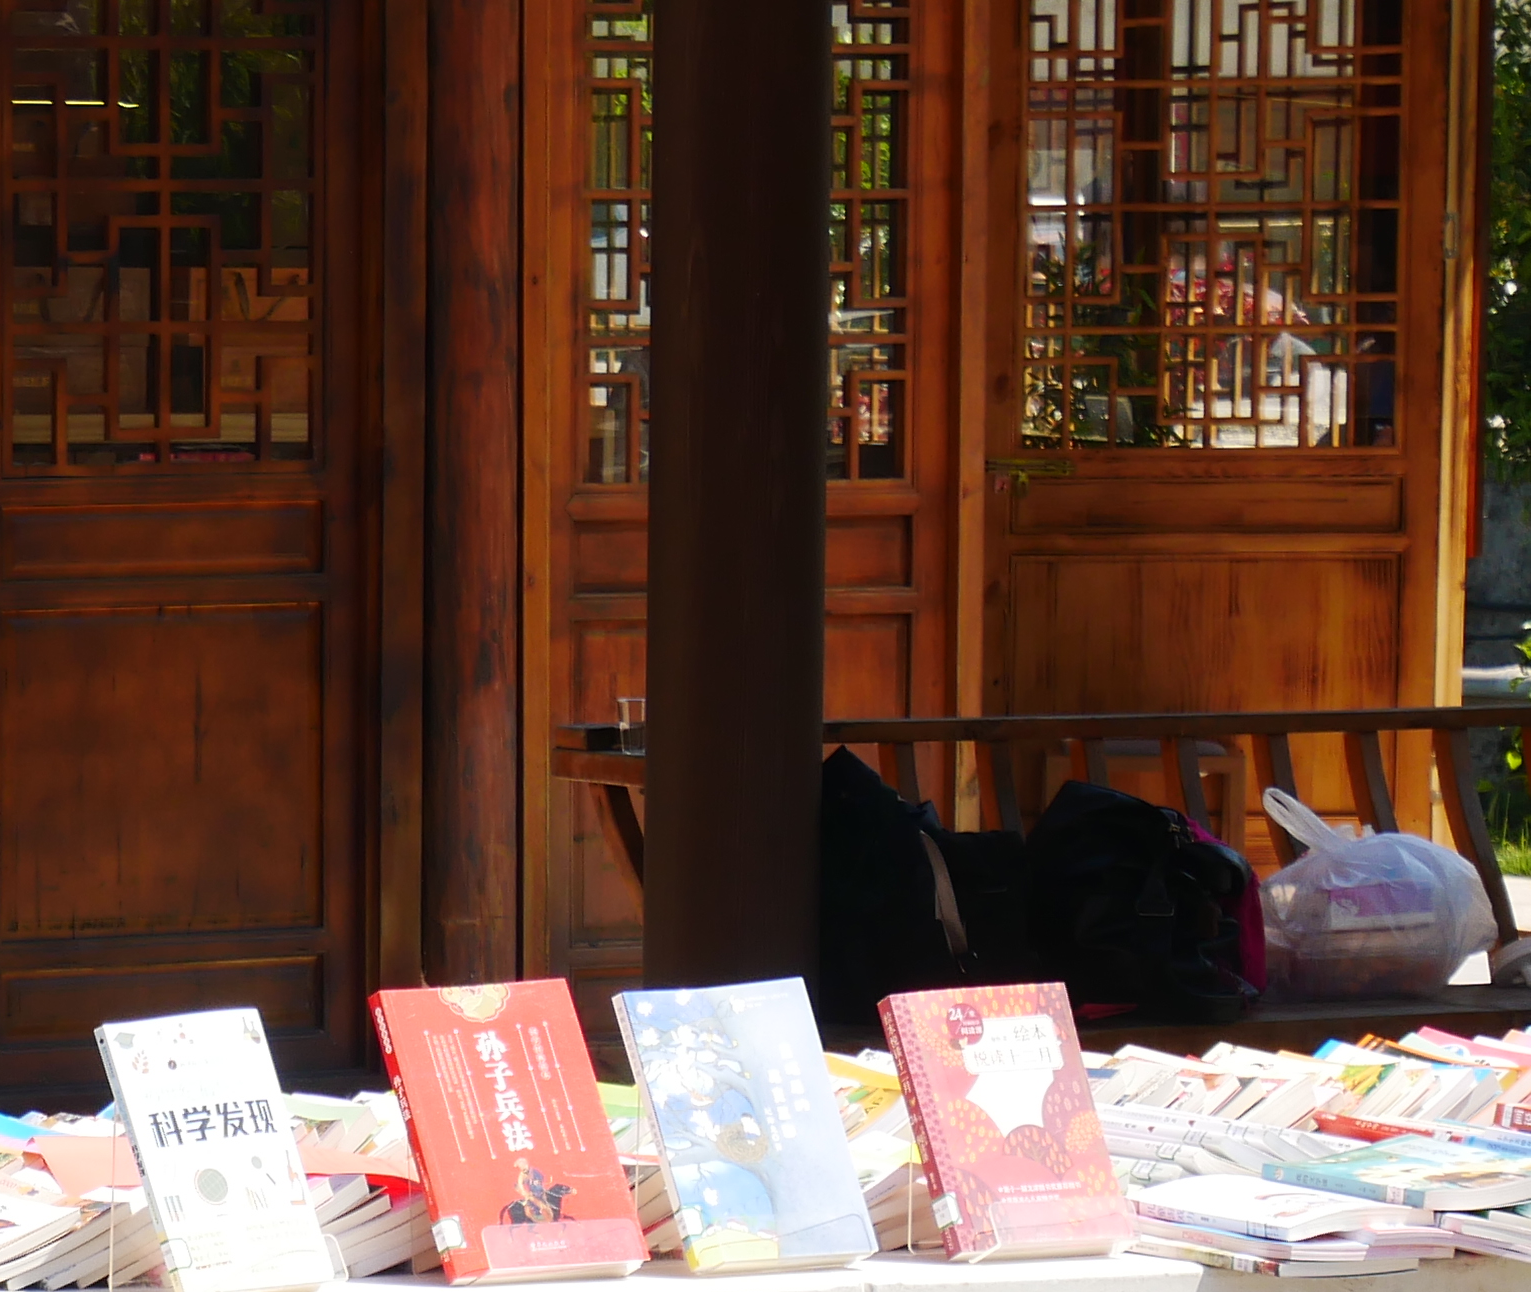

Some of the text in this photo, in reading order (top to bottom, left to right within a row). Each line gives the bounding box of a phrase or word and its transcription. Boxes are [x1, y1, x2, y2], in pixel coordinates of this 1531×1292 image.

[948, 1008, 963, 1021] 24
[1013, 1024, 1047, 1042] 绘本
[973, 1046, 1052, 1067] 悦读十二月
[472, 1029, 535, 1152] 孙子兵法
[148, 1098, 279, 1149] 科学发现
